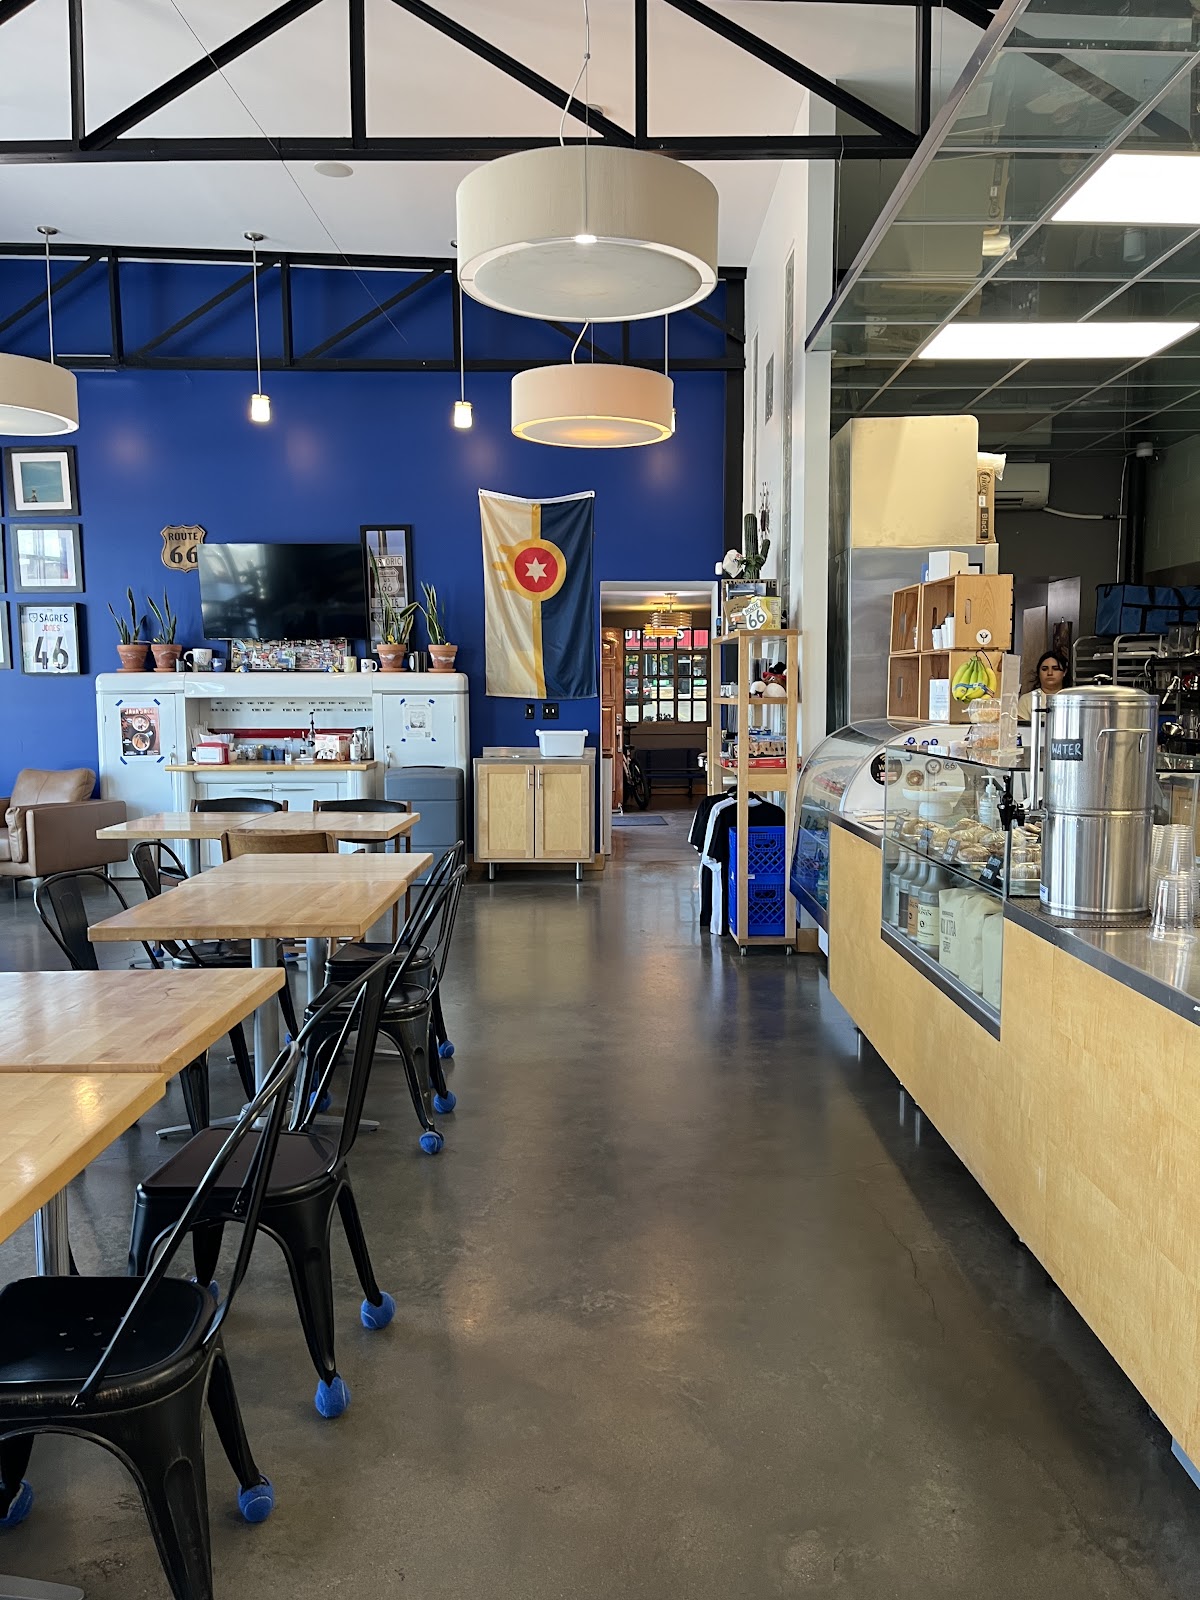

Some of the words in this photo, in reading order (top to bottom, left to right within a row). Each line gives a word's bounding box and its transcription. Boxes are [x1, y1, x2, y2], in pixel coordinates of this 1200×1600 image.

[168, 532, 199, 541] ROUTE
[170, 545, 198, 564] 66
[381, 583, 393, 592] 66
[744, 602, 760, 616] ROUTE
[39, 613, 69, 623] SAGRES
[748, 609, 766, 628] 66
[33, 636, 69, 670] 46
[1052, 743, 1082, 756] WATER
[944, 762, 956, 770] 66
